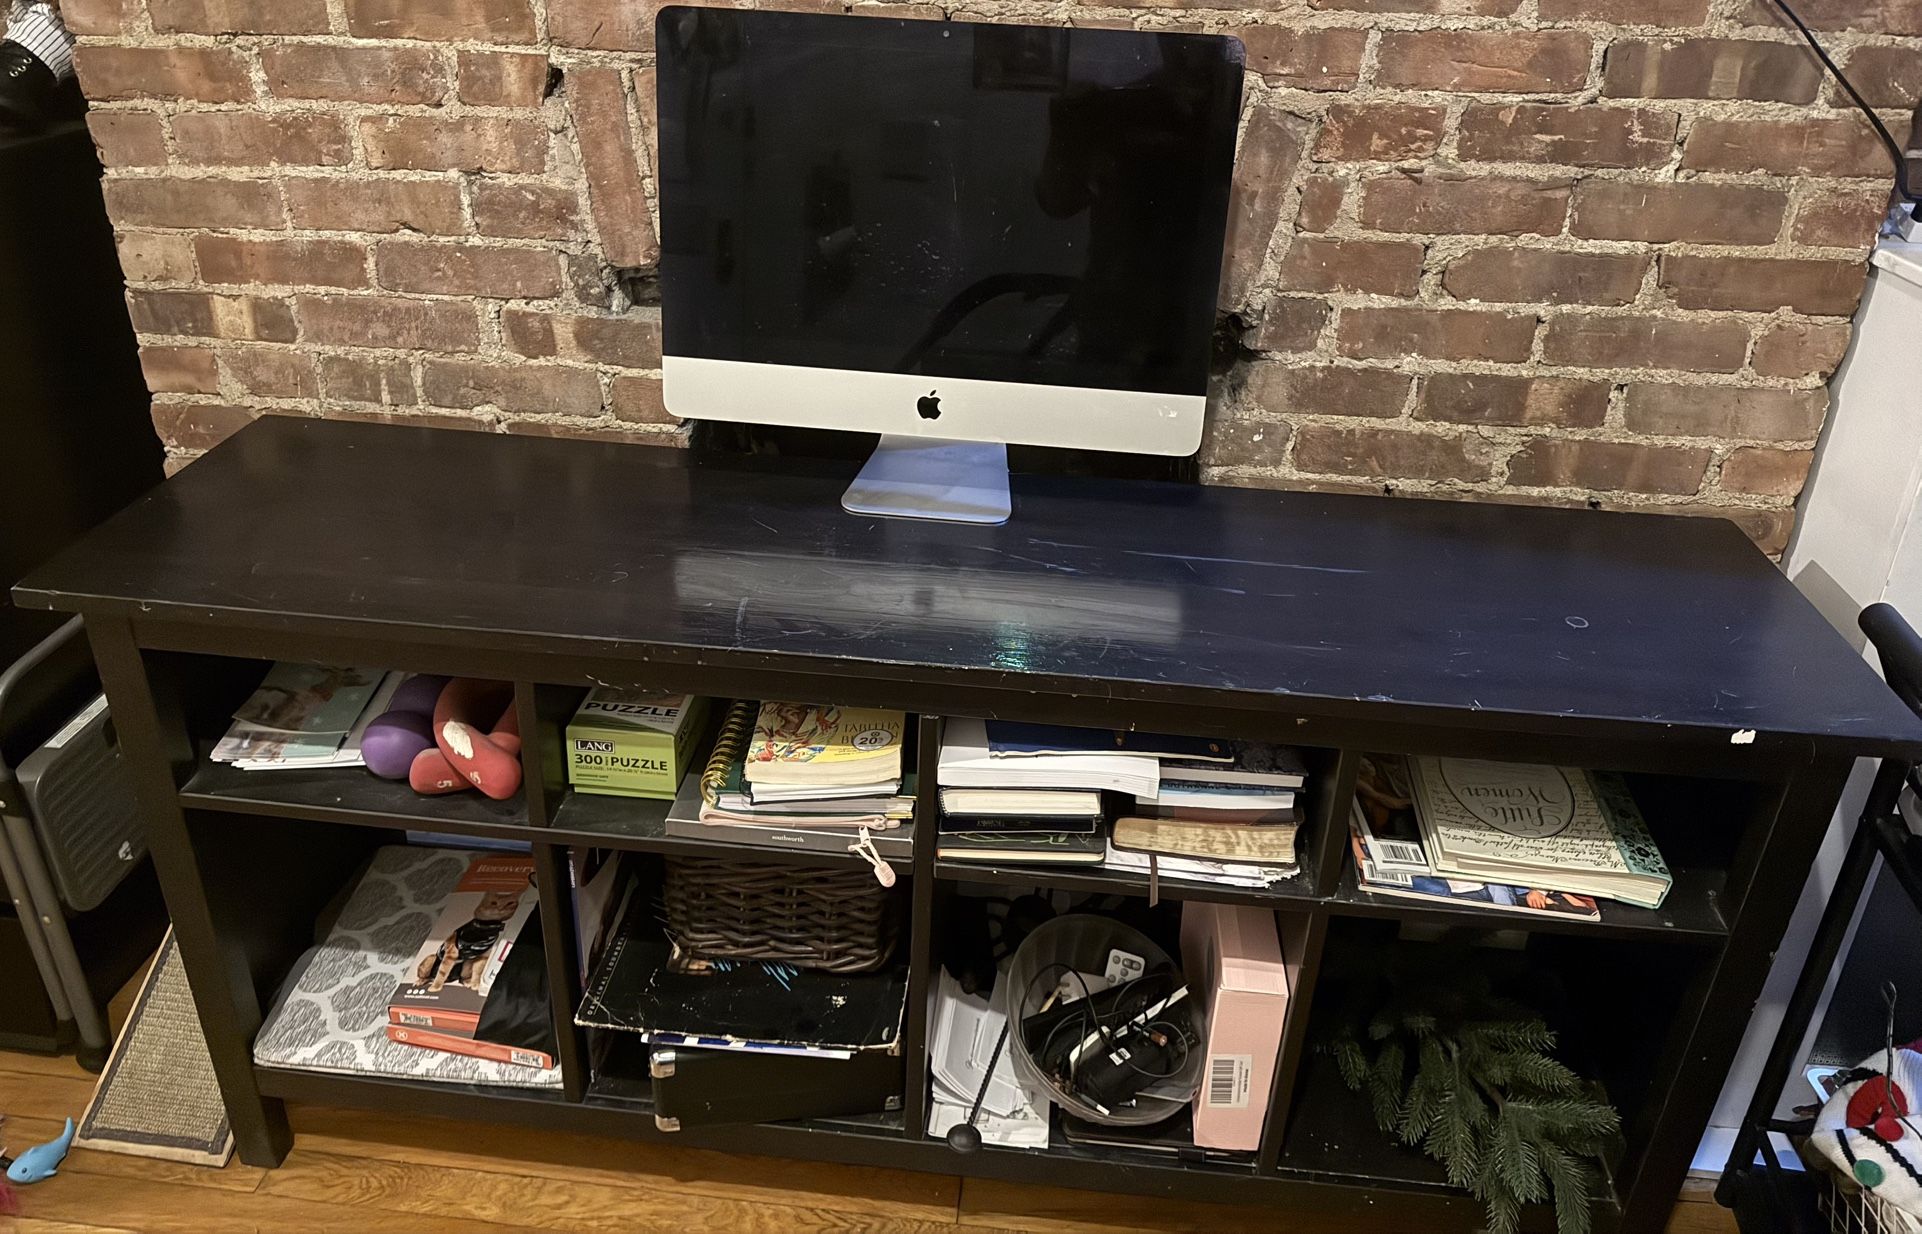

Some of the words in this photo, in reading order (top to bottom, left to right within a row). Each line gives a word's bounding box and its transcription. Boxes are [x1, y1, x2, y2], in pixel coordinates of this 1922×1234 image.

[585, 702, 680, 717] PUZZLE
[576, 740, 612, 752] LANG
[575, 754, 603, 765] 300
[611, 756, 668, 771] PUZZLE
[1460, 786, 1562, 805] Women
[1484, 806, 1562, 827] Little
[771, 834, 804, 843] southworth
